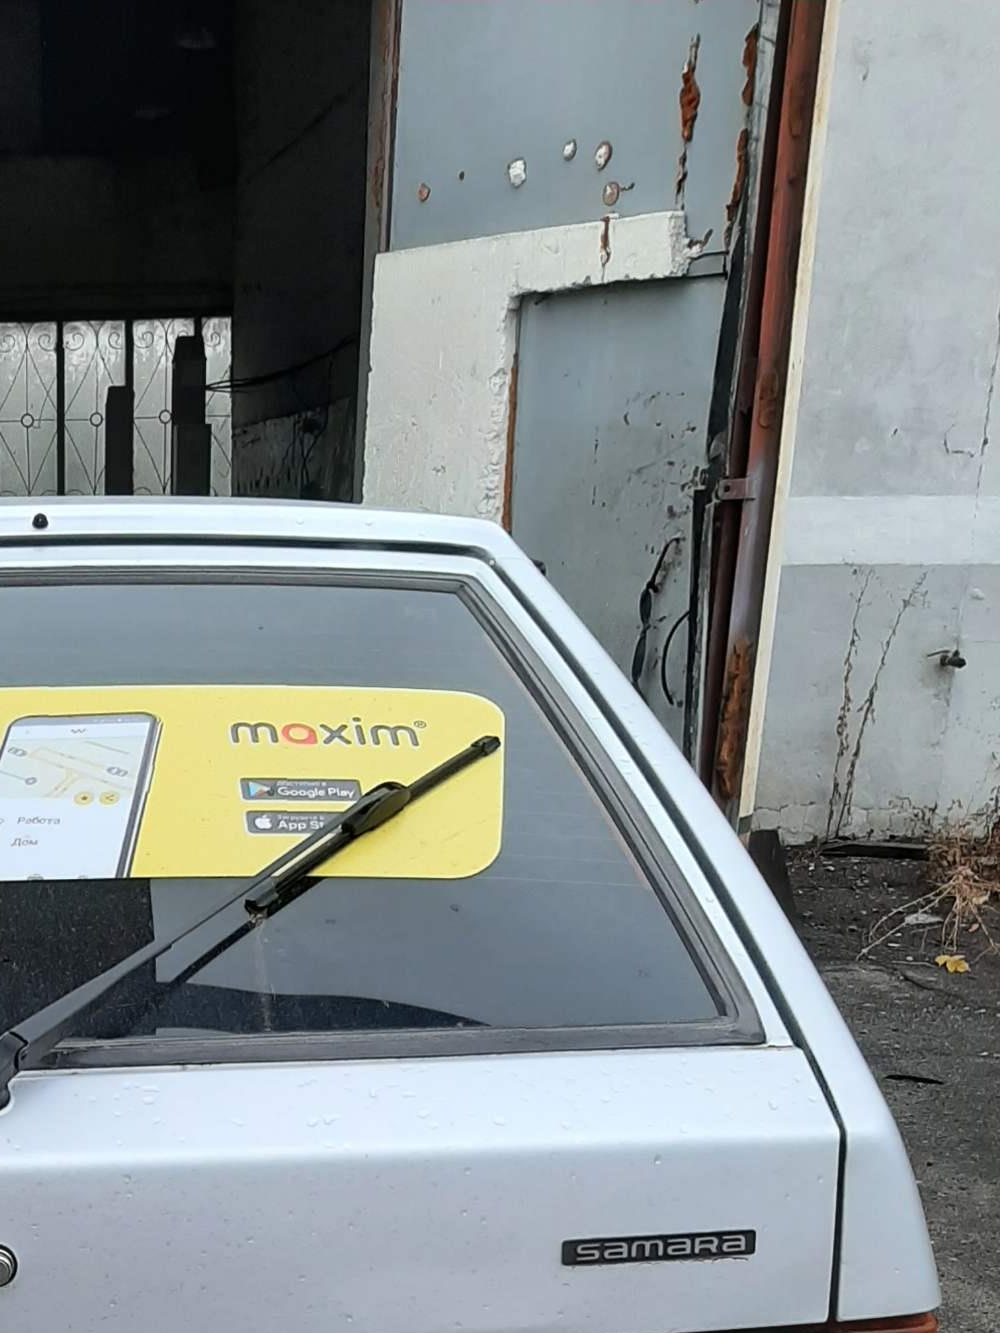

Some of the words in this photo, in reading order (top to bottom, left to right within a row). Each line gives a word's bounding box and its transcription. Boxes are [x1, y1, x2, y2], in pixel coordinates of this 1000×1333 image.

[277, 786, 325, 799] Google
[327, 787, 355, 799] Play
[17, 816, 60, 825] Работа
[278, 820, 307, 831] App
